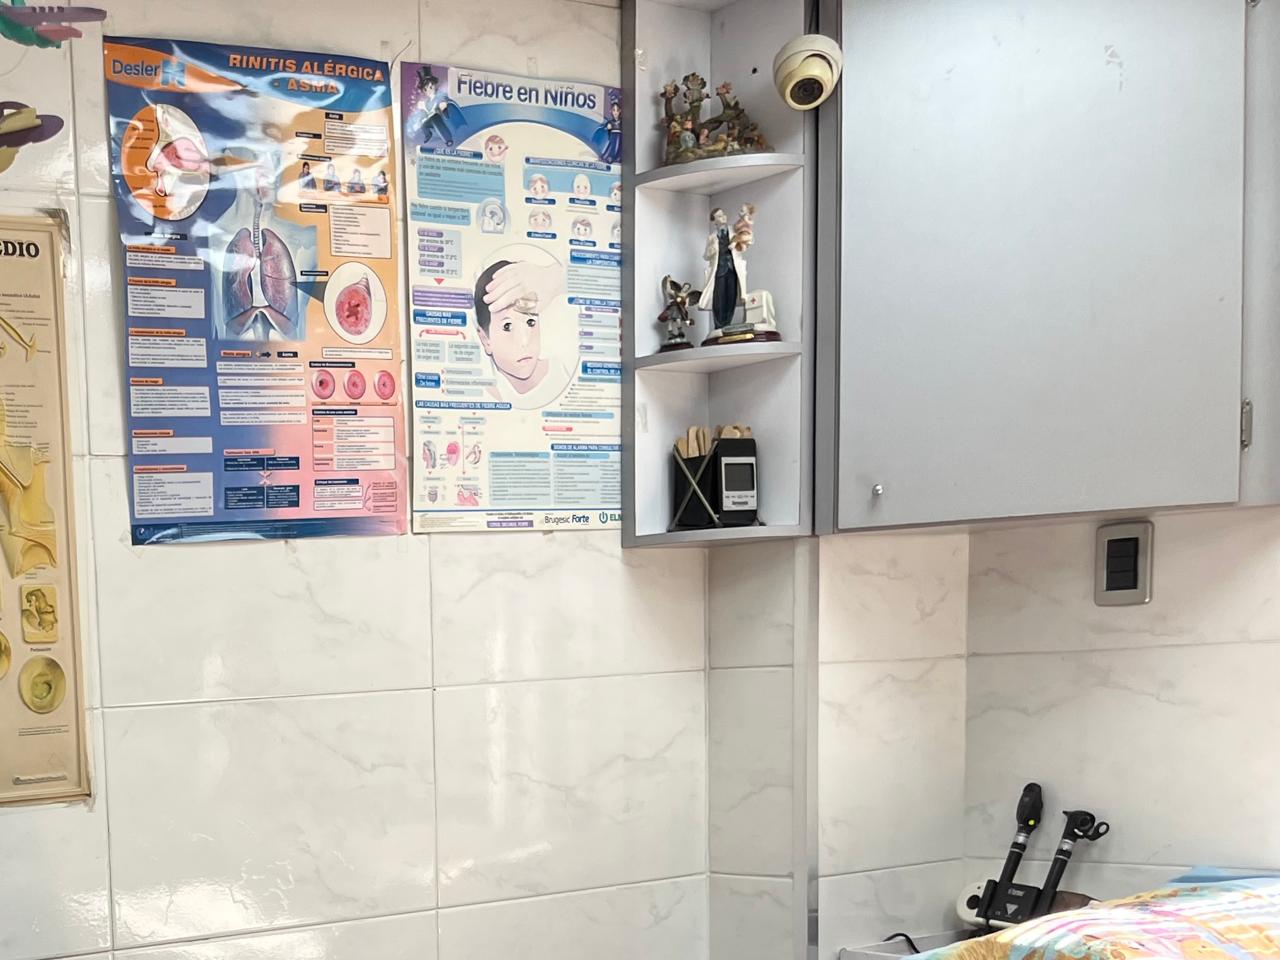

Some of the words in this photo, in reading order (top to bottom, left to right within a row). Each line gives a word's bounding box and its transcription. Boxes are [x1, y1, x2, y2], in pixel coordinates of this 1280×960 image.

[229, 54, 296, 73] RINITIS
[301, 58, 384, 82] ALÉRGICA
[287, 78, 339, 93] ASMA
[457, 73, 513, 100] Fiebre
[517, 86, 539, 104] en
[544, 85, 596, 109] Niños
[572, 513, 589, 524] Forte
